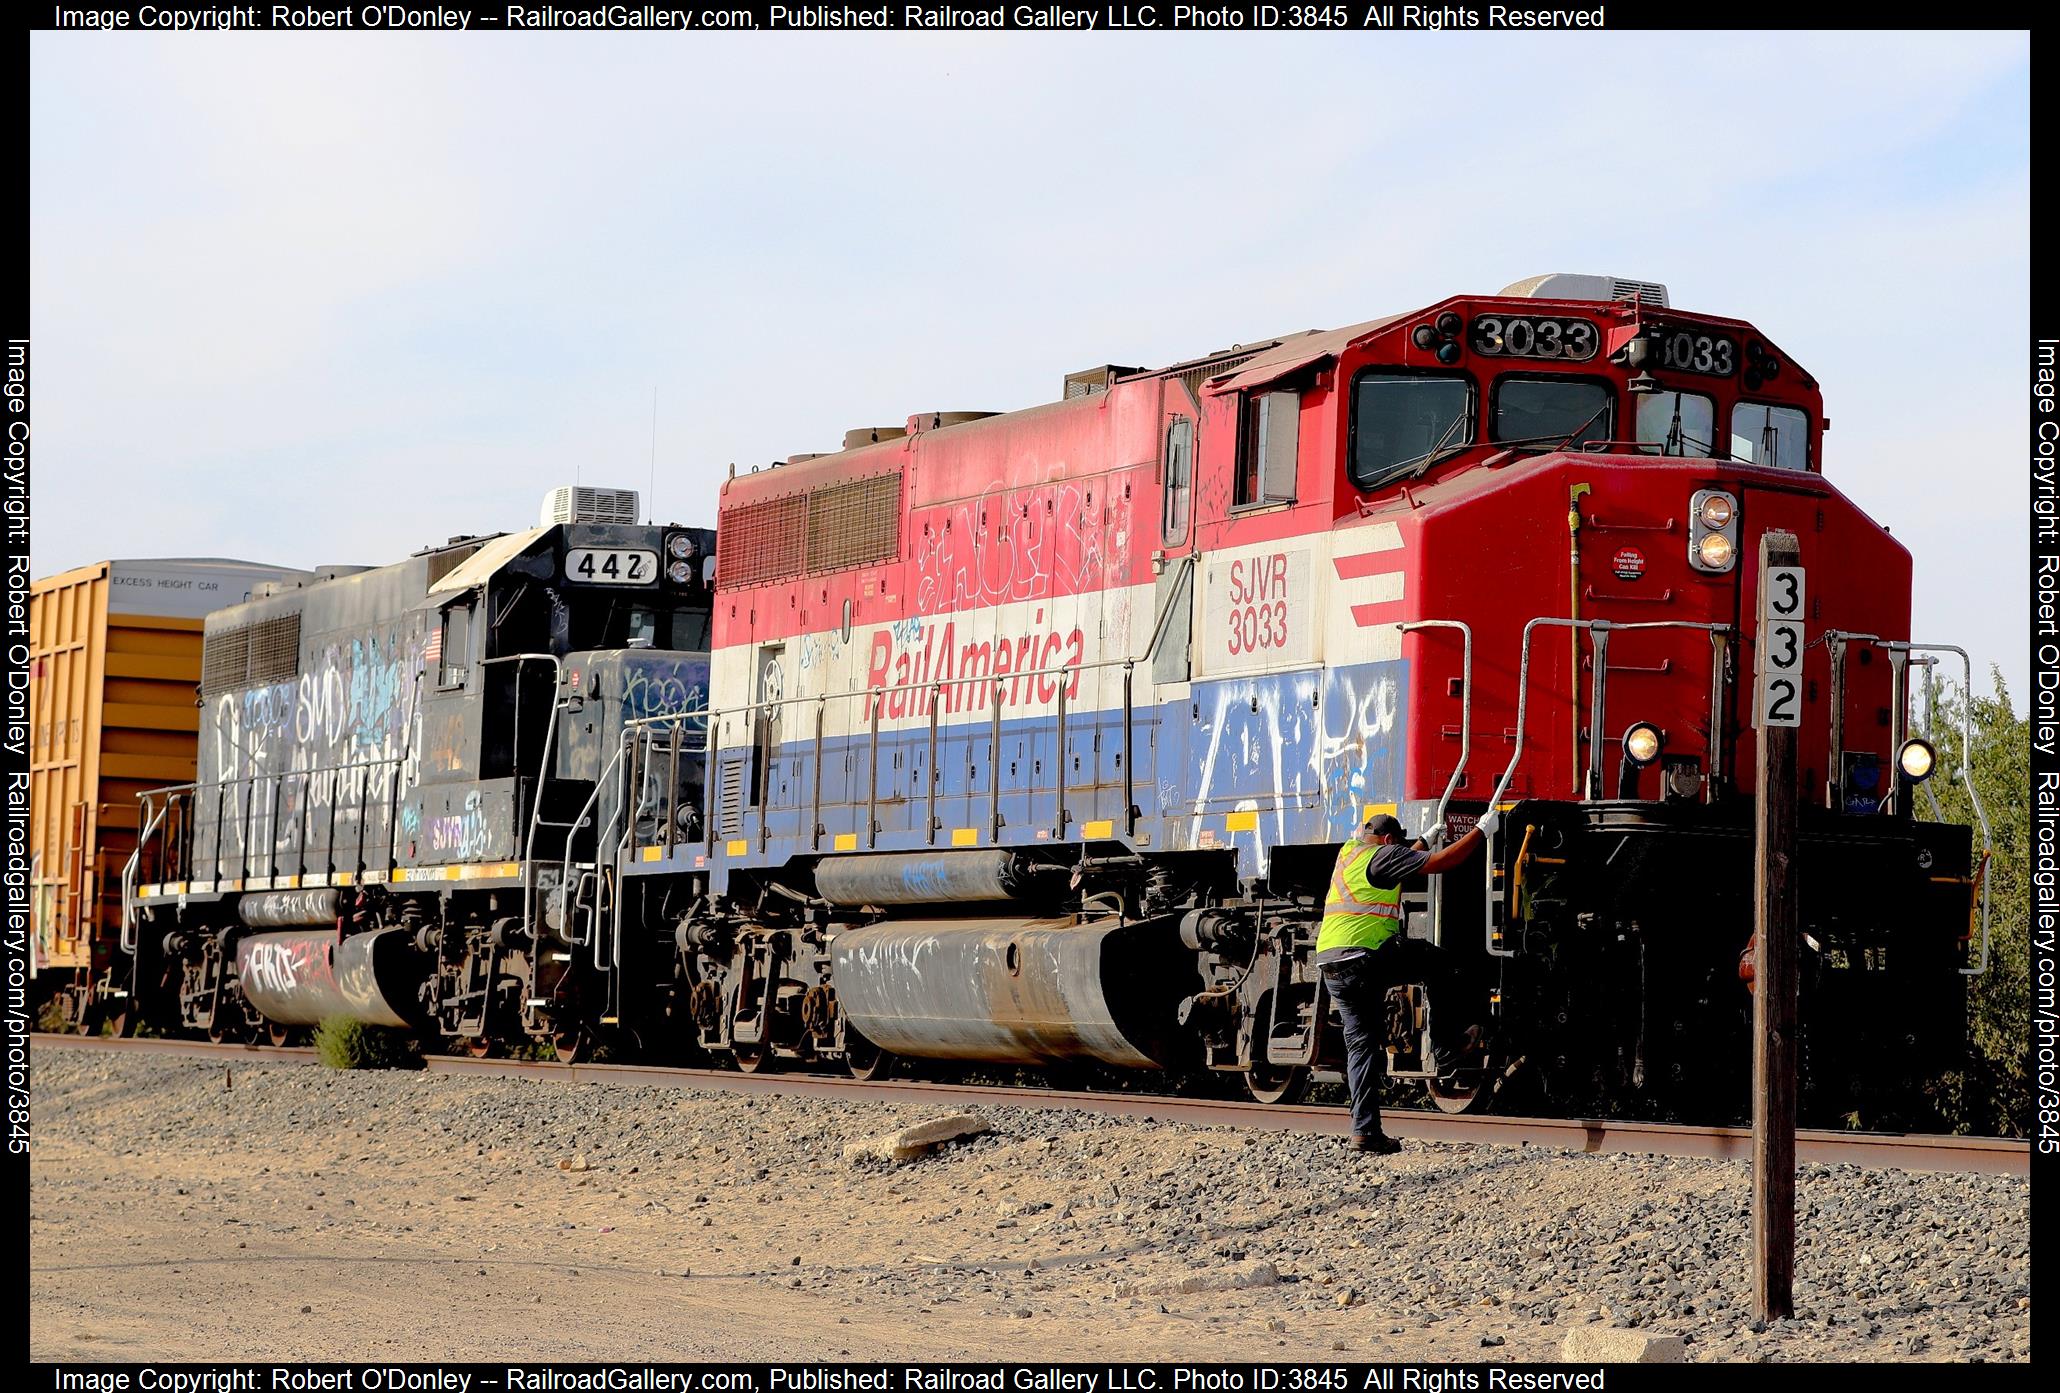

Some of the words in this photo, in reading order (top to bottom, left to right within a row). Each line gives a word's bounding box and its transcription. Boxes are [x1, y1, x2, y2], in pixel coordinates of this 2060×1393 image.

[1475, 318, 1592, 358] 3033
[113, 576, 152, 587] EXCESS
[158, 580, 192, 589] HEIGHT
[198, 582, 219, 591] CAR
[578, 553, 641, 579] 442
[1230, 553, 1287, 605] SJVR
[1228, 600, 1287, 655] 3033
[864, 608, 1084, 723] RailAmerica
[1448, 815, 1480, 824] WATCH
